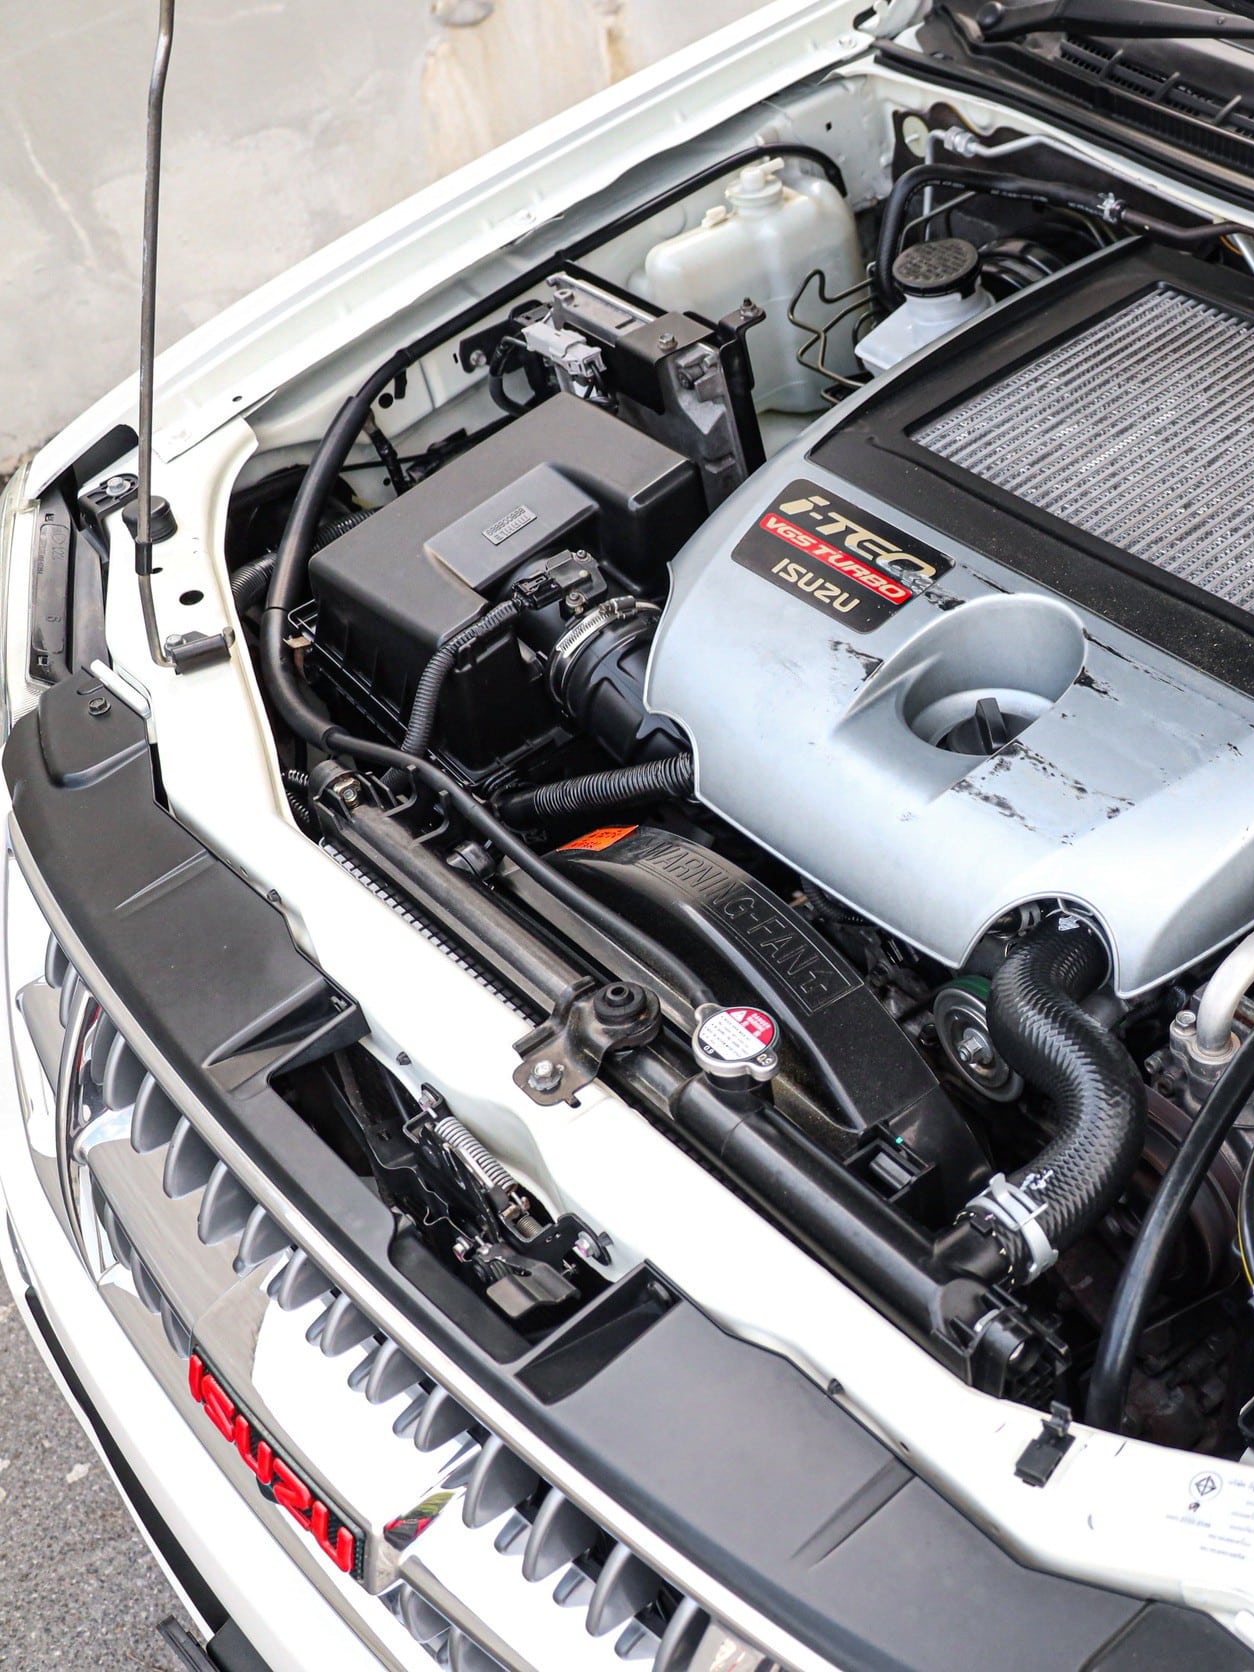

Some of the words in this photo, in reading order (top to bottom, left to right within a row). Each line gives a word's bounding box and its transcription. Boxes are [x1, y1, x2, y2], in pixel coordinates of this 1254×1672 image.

[765, 517, 815, 548] VGS
[814, 546, 908, 600] TURBO
[771, 557, 861, 614] ISUZU
[188, 1353, 354, 1574] ISUZU
